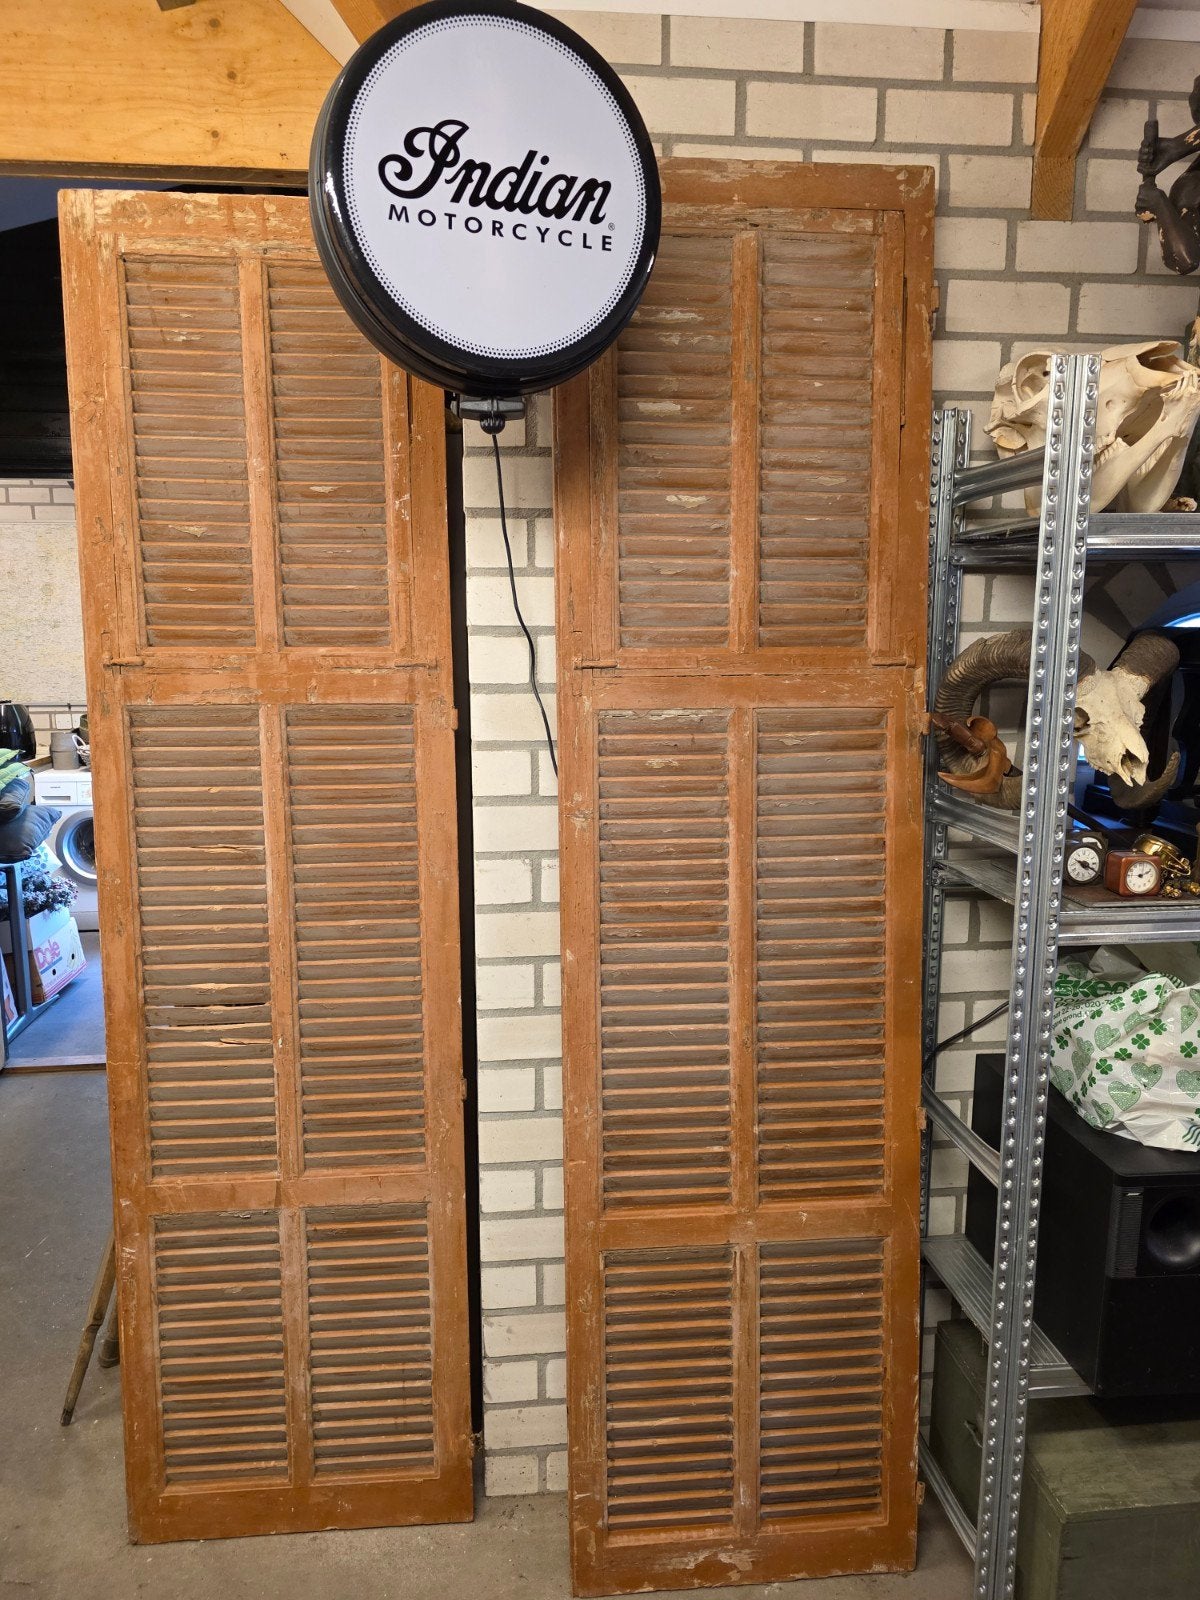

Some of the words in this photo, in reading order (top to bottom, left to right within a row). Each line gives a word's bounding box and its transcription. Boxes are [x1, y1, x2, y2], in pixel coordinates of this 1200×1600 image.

[378, 119, 612, 225] Indian
[388, 203, 613, 251] MOTORCYCLE
[34, 939, 60, 968] Dole
